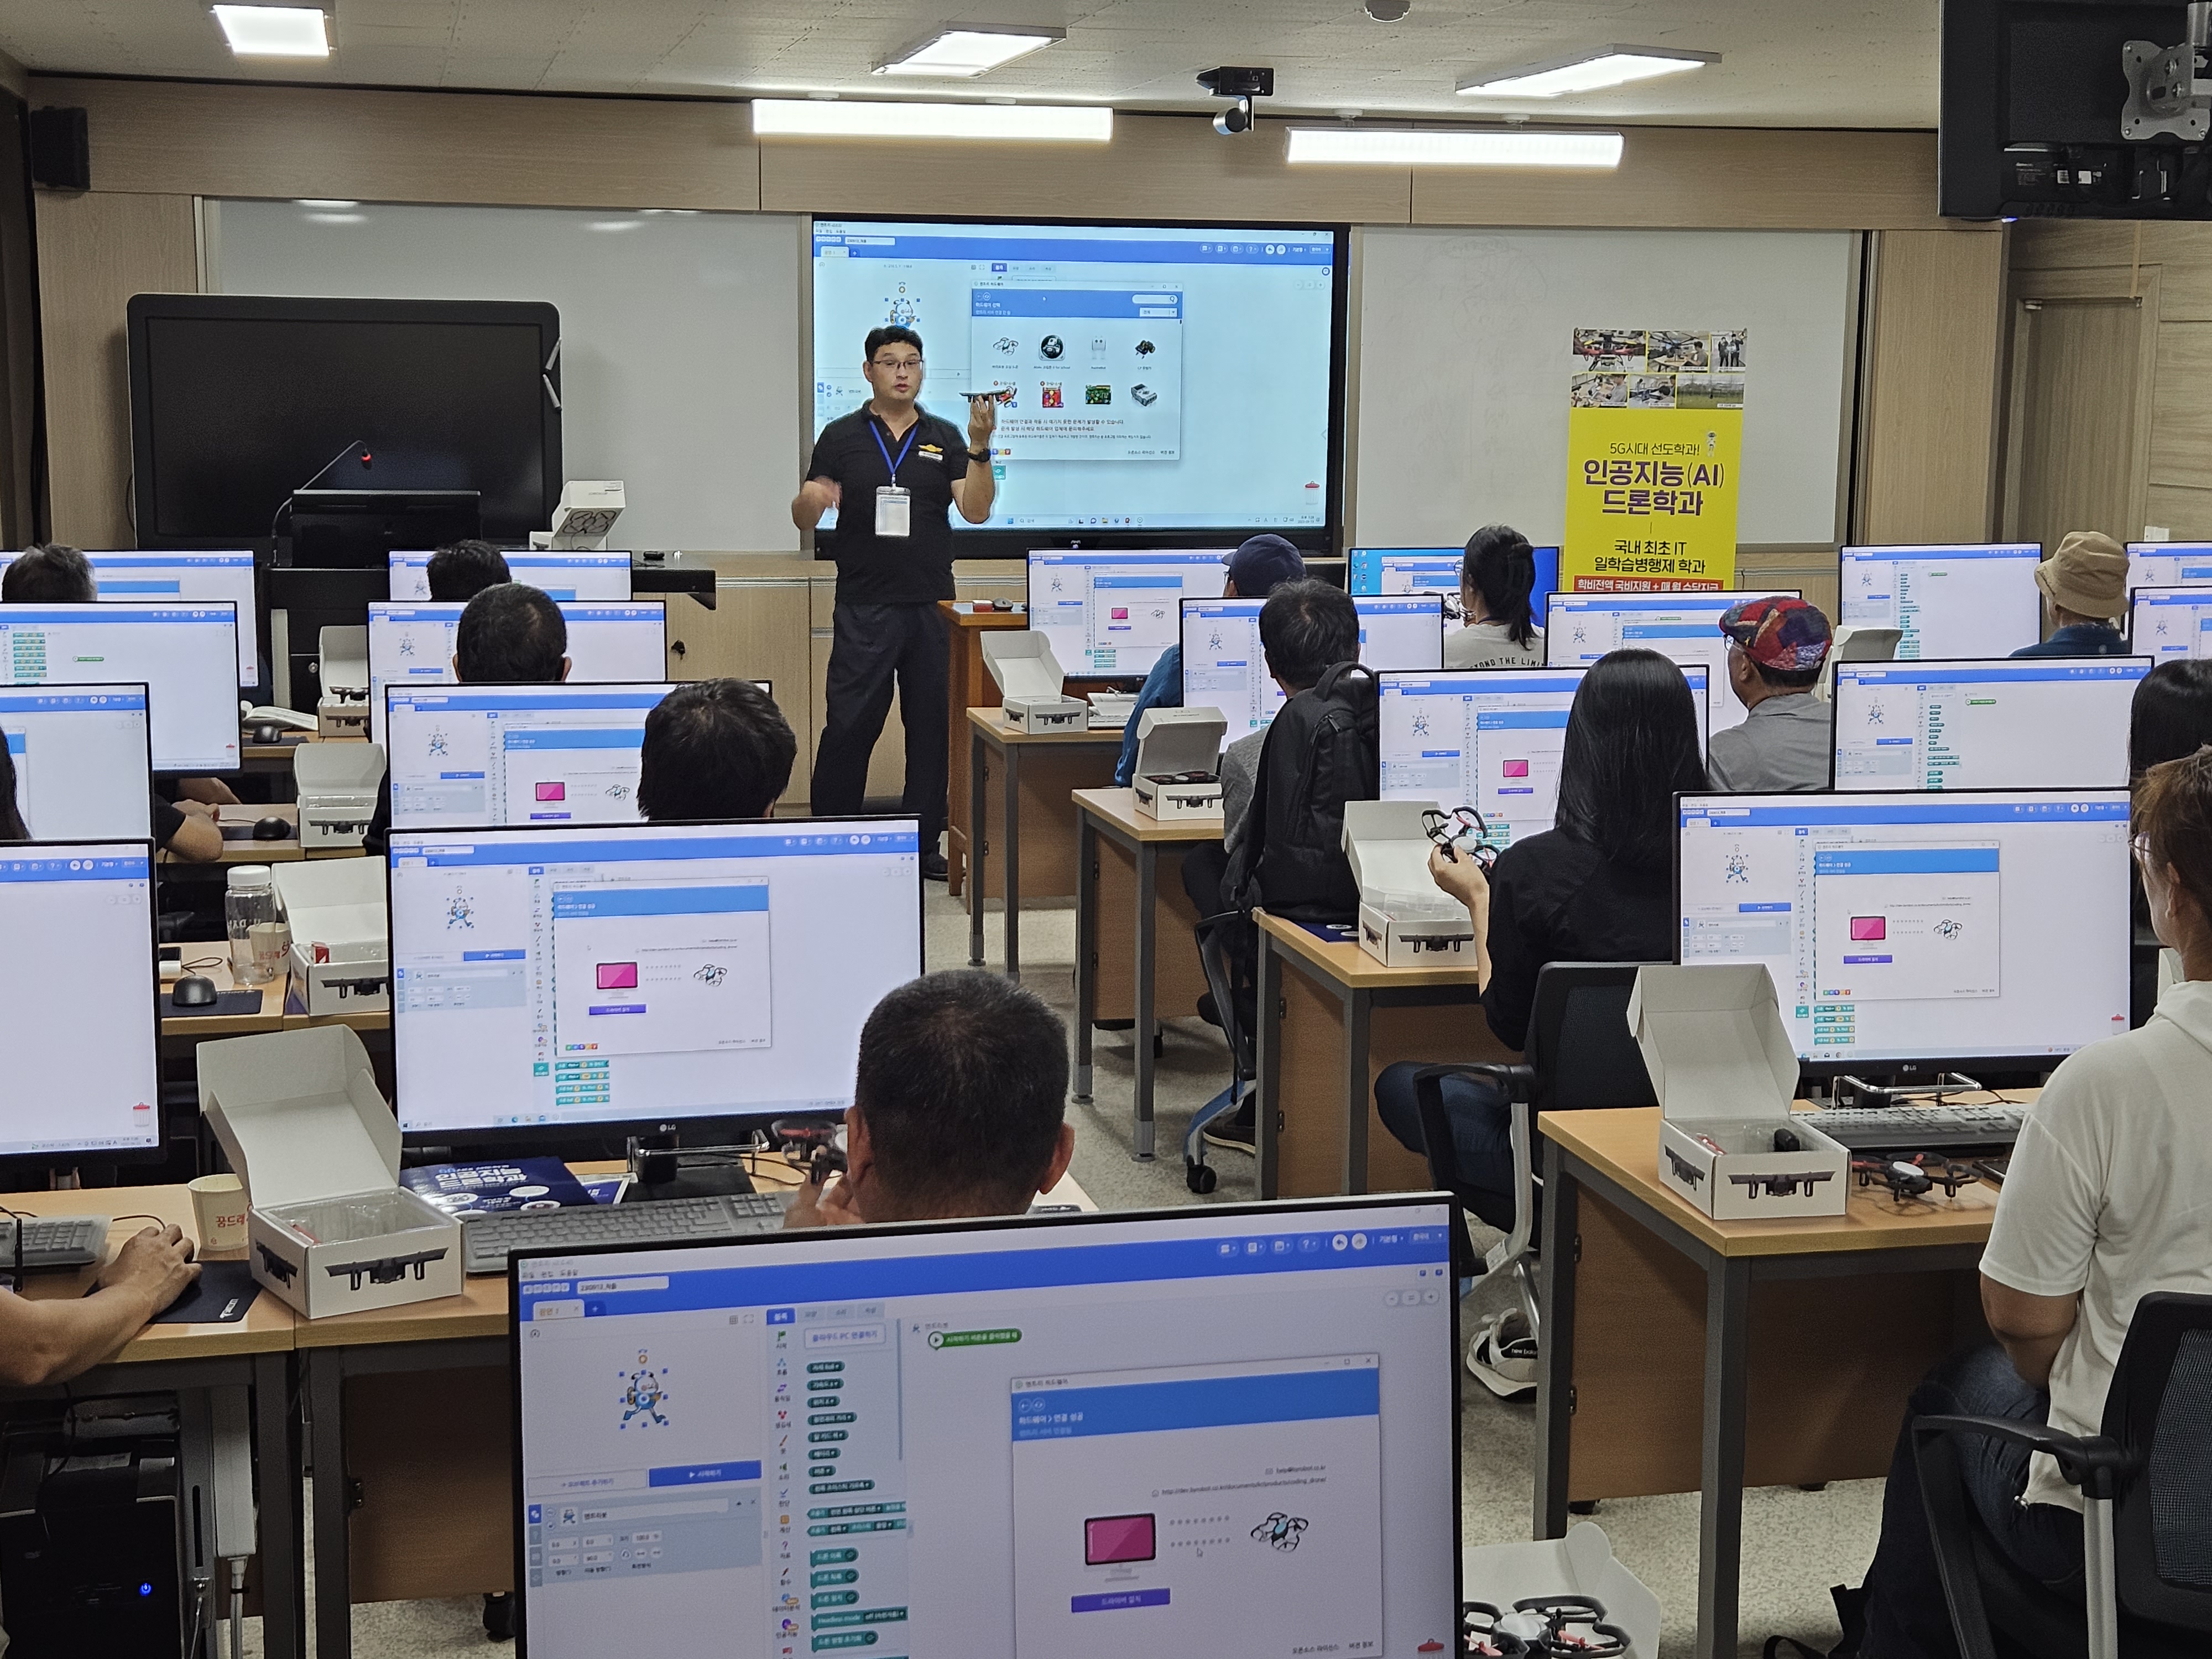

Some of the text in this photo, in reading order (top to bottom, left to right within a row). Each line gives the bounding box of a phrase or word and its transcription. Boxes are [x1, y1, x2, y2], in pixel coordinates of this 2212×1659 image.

[1609, 442, 1700, 457] 5G시대 선도학과!
[1584, 460, 1725, 489] 인공지능(AI)
[1602, 489, 1703, 515] 드론학과
[1614, 540, 1687, 555] 국내 최초 IT
[1595, 556, 1706, 574] 일학습병행제 학과
[1578, 578, 1614, 591] 학비전액
[1615, 580, 1651, 591] 국비지원
[1661, 582, 1670, 591] 매
[774, 1312, 788, 1321] 블록
[813, 1333, 838, 1342] 클라우드
[852, 1331, 878, 1339] 연결하기
[1019, 1415, 1046, 1425] 하드웨어
[1053, 1413, 1067, 1422] 연결
[1070, 1411, 1083, 1422] 성공
[697, 1469, 722, 1478] 시작하기
[1129, 1594, 1141, 1604] 설치
